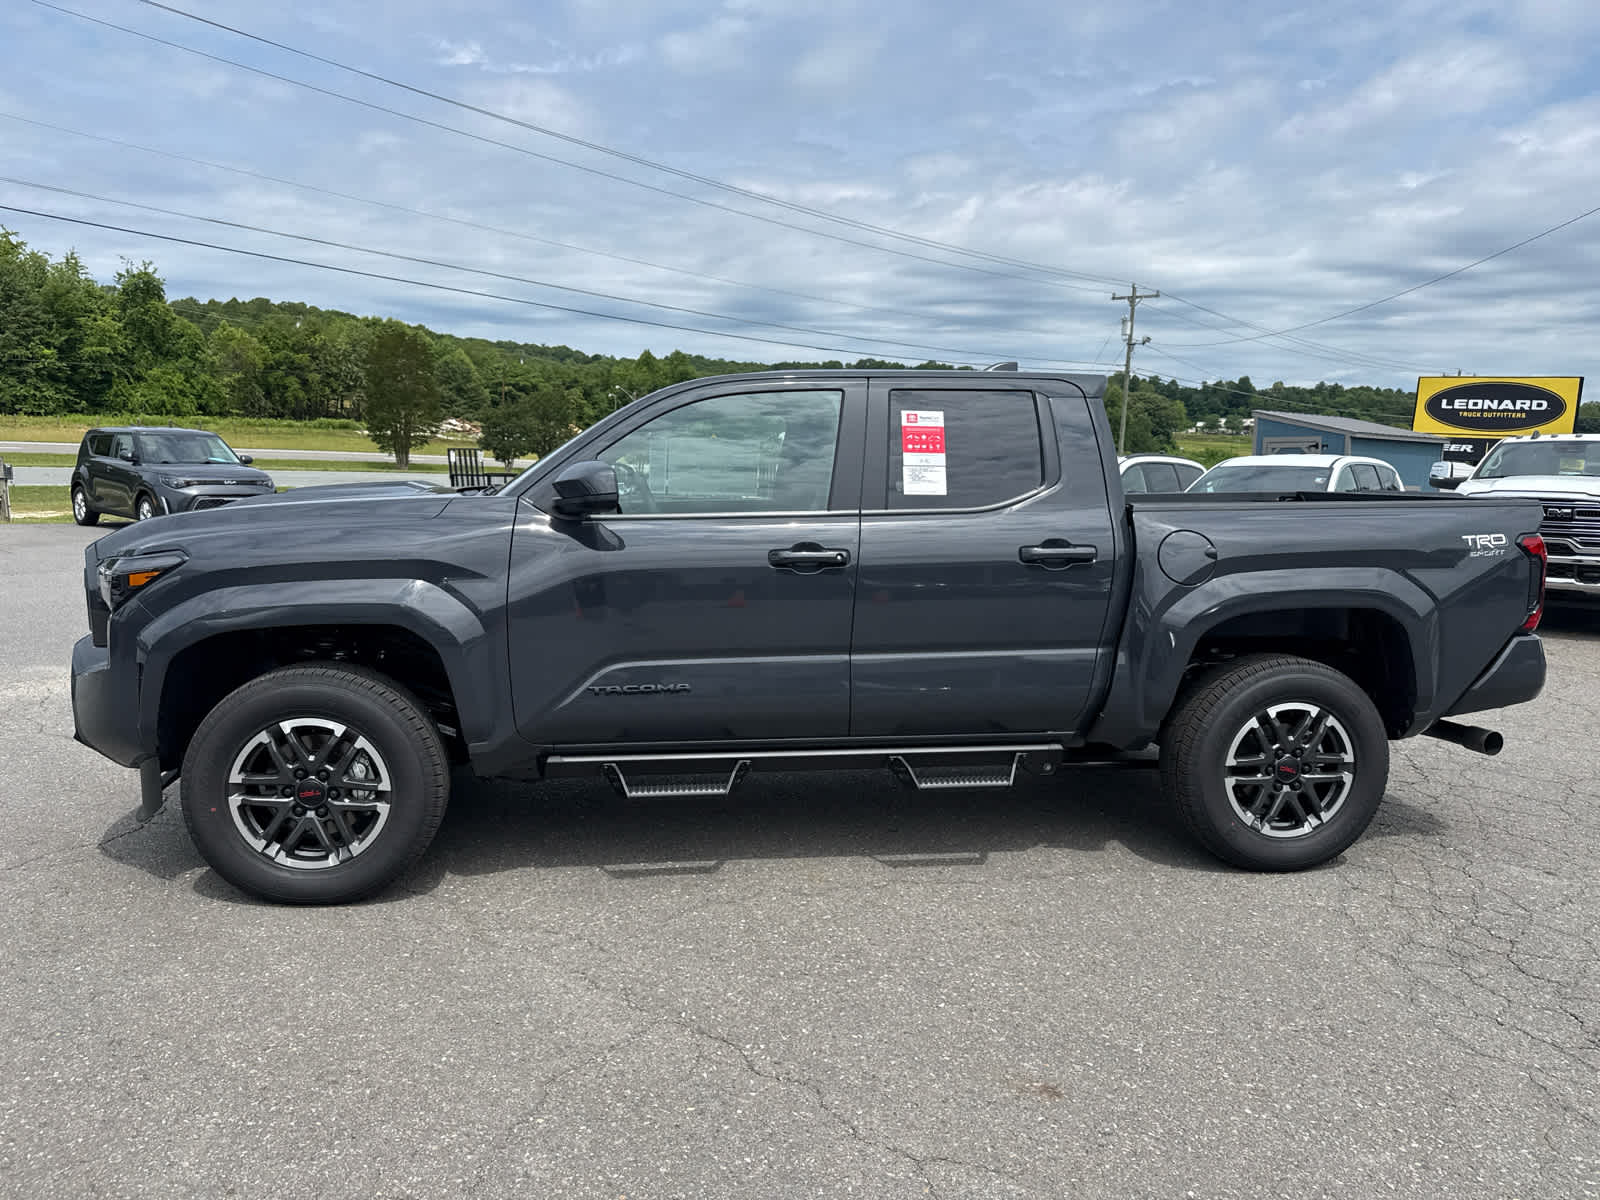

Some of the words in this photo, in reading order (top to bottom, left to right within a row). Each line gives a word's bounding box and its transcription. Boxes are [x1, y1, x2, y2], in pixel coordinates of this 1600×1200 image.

[1441, 399, 1548, 411] LEONARD
[1483, 411, 1526, 419] OUTFITTERS
[1461, 534, 1506, 549] TRD
[588, 683, 691, 696] TACOMA
